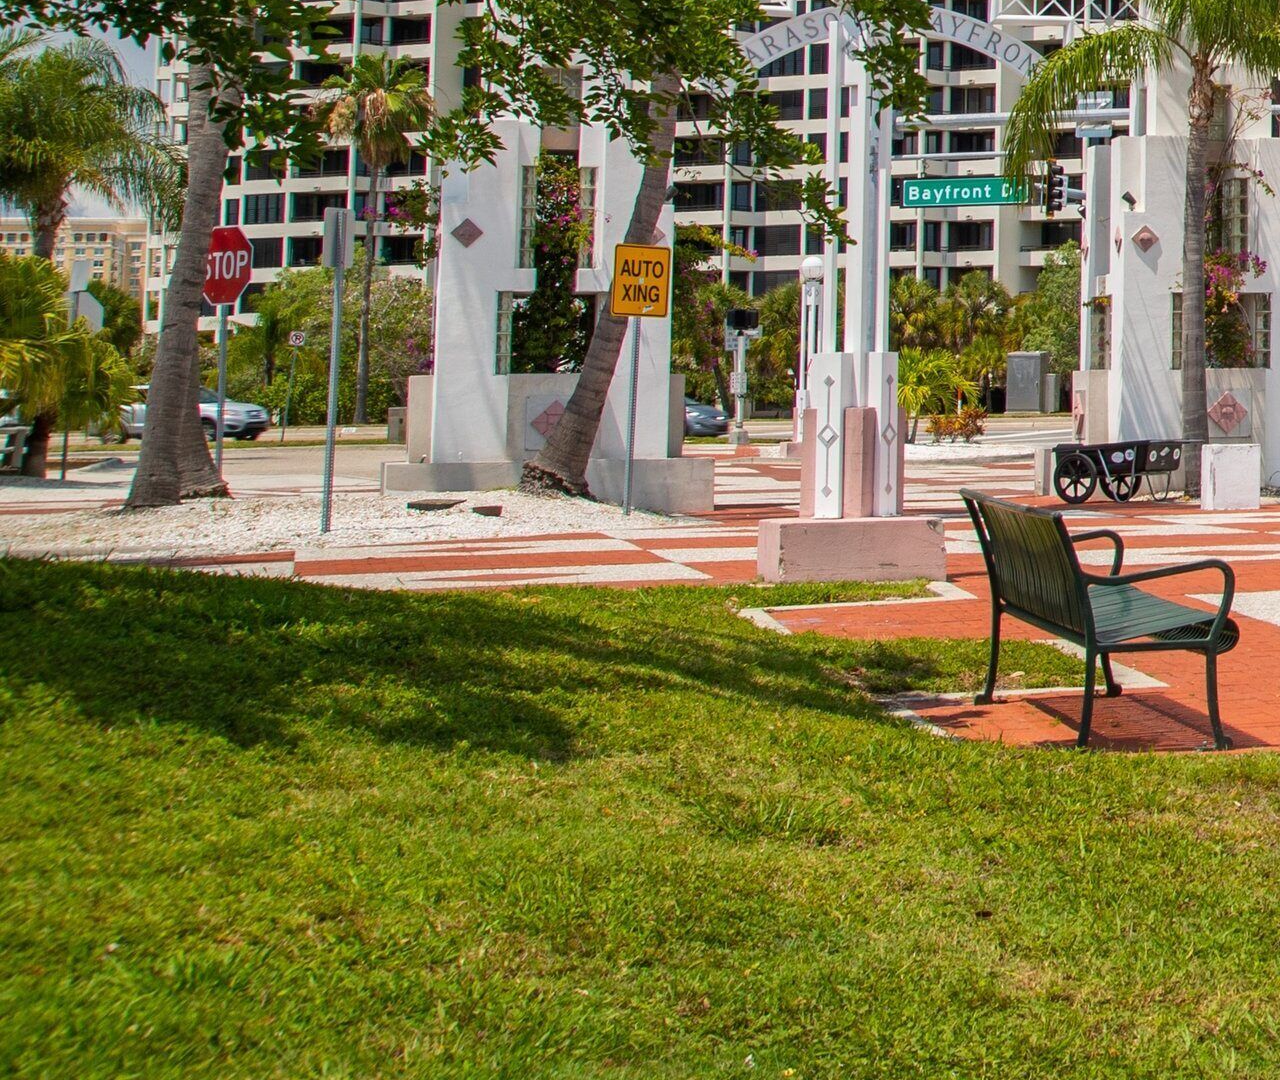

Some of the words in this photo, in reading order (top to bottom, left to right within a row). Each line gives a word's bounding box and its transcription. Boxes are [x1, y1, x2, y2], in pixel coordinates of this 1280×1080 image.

[908, 183, 992, 203] Bayfront
[620, 258, 664, 278] AUTO
[621, 283, 660, 303] XING
